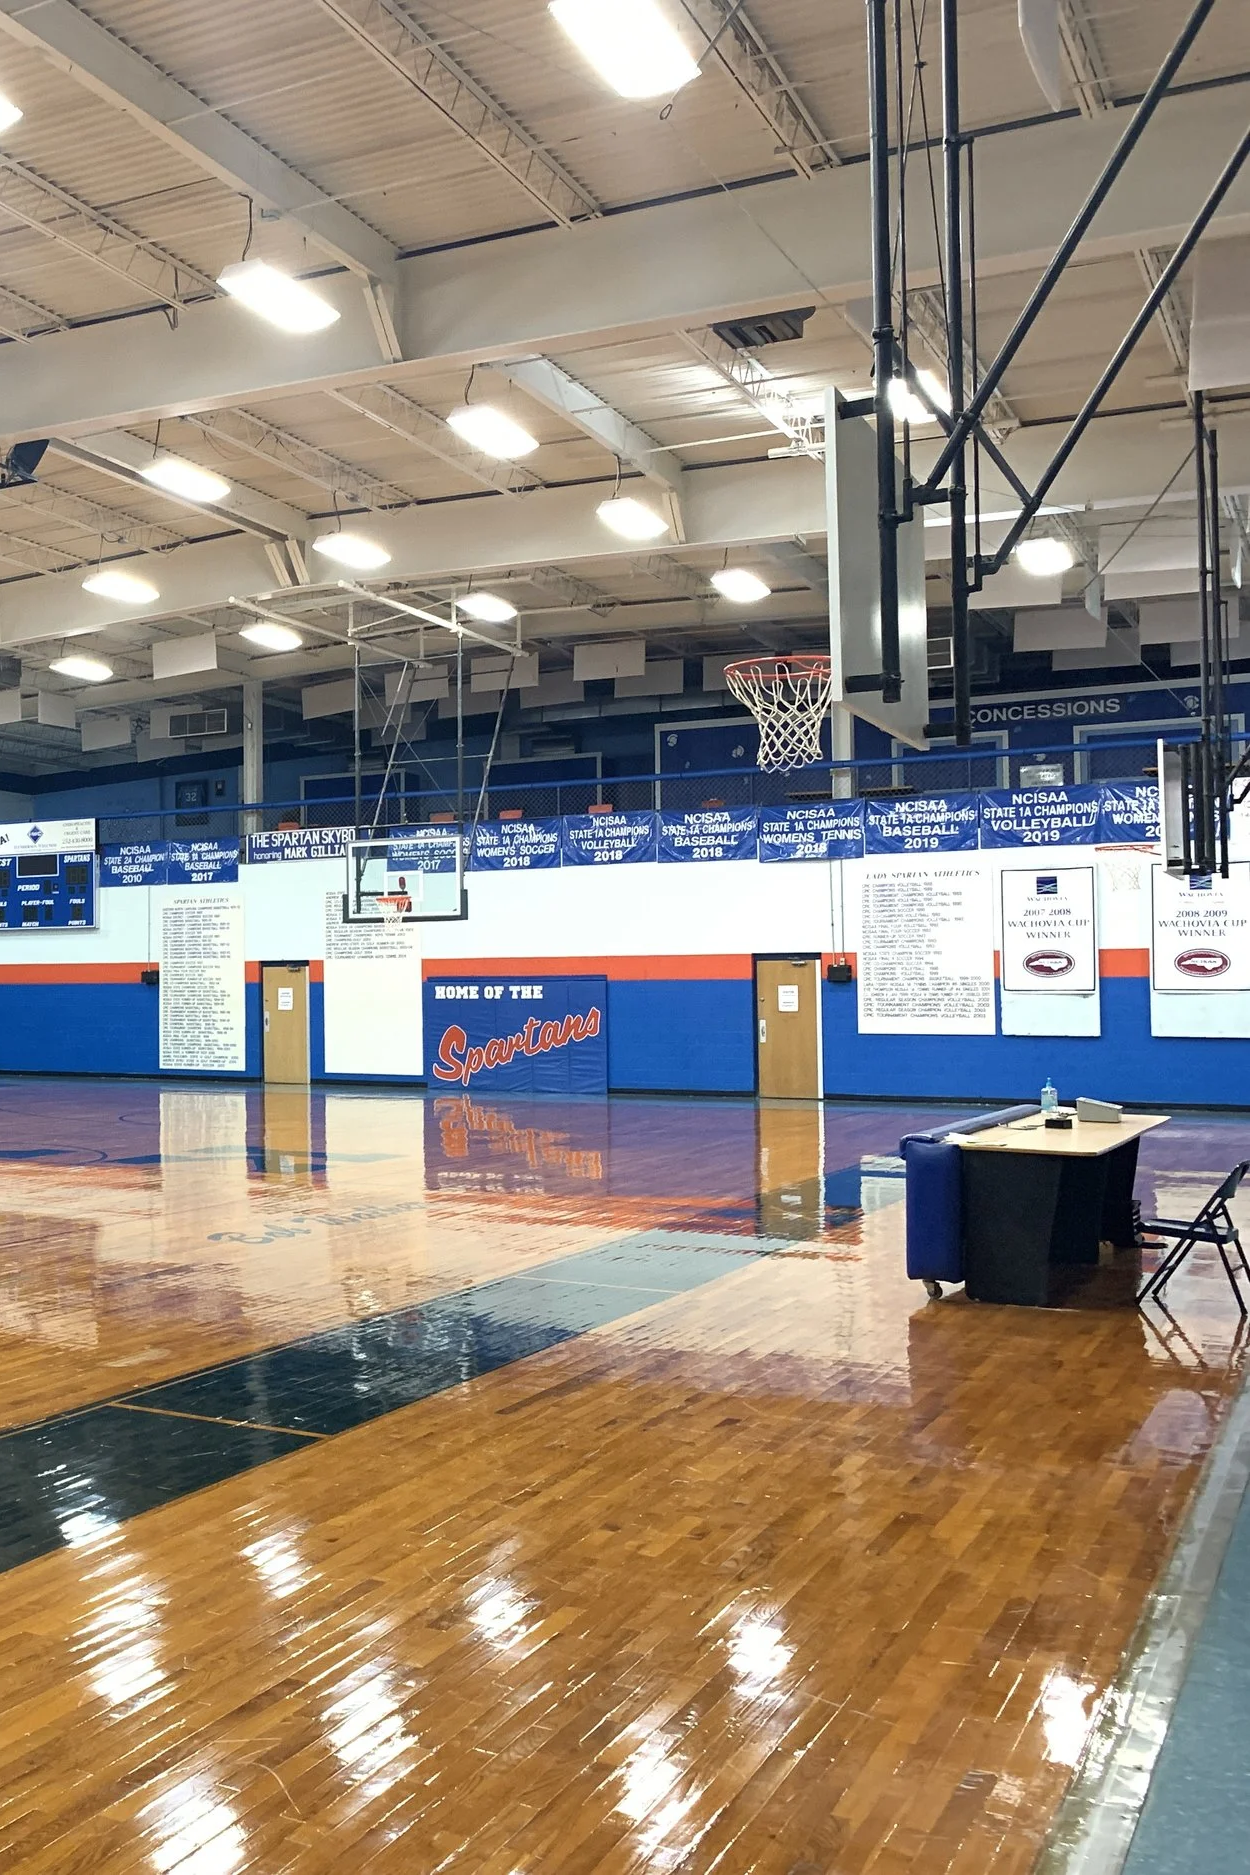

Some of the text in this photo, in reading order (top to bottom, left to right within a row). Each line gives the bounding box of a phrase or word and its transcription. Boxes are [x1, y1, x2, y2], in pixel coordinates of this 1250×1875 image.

[1012, 791, 1069, 805] NCISAA
[895, 800, 947, 813] NCISAA
[983, 801, 1098, 819] STATE 1A CHAMPIONS
[1104, 800, 1140, 812] STATE
[684, 811, 731, 825] NCISAA
[786, 808, 836, 820] NCISAA
[868, 810, 975, 826] STATE 1A CHAMPIONS
[592, 815, 627, 827] NCISAA
[762, 816, 860, 833] STATE 1A CHAMPIONS
[991, 815, 1096, 831] VOLLEYBALL
[501, 823, 535, 834] NCISAA
[570, 825, 649, 840] STATE 1A CHAMPIONS
[661, 820, 753, 836] STATE 1A CHAMPIONS
[882, 824, 960, 837] BASEBALL
[251, 834, 269, 849] THE
[271, 830, 320, 847] SPARTAN
[476, 836, 499, 846] STATE
[502, 835, 511, 845] 1A
[513, 833, 558, 845] CHAMPIONS
[674, 835, 739, 847] BASEBALL
[762, 829, 862, 844] WOMENS TENNIS
[1023, 830, 1060, 843] 2019
[190, 842, 219, 852] NCISAA
[581, 837, 637, 850] VOLLEYBALL
[796, 842, 828, 855] 2018
[904, 837, 939, 849] 2019
[120, 845, 151, 855] NCISAA
[201, 849, 238, 861] CHAMPIONS
[253, 844, 346, 861] honoring MARK GILLIA
[519, 844, 555, 855] SOCCER
[692, 847, 723, 859] 2018
[63, 854, 90, 864] SPARTANS
[104, 856, 121, 866] STATE
[503, 856, 531, 868] 2018
[594, 850, 623, 862] 2018
[111, 863, 154, 874] BASEBALL
[184, 860, 222, 871] BASEBALL
[417, 860, 442, 871] 2017
[122, 874, 143, 884] 2010
[191, 872, 214, 882] 2017
[891, 871, 929, 879] SPARTAN
[933, 869, 981, 878] ATHLETICS
[1202, 909, 1228, 918] 2009
[1007, 918, 1067, 928] WACHOVIA
[1157, 918, 1248, 928] WACHOVIA CUP
[1026, 930, 1072, 939] WINNER
[1177, 928, 1227, 937] WINNER
[434, 985, 544, 1000] HOME OF THE
[432, 1005, 602, 1087] Spartans
